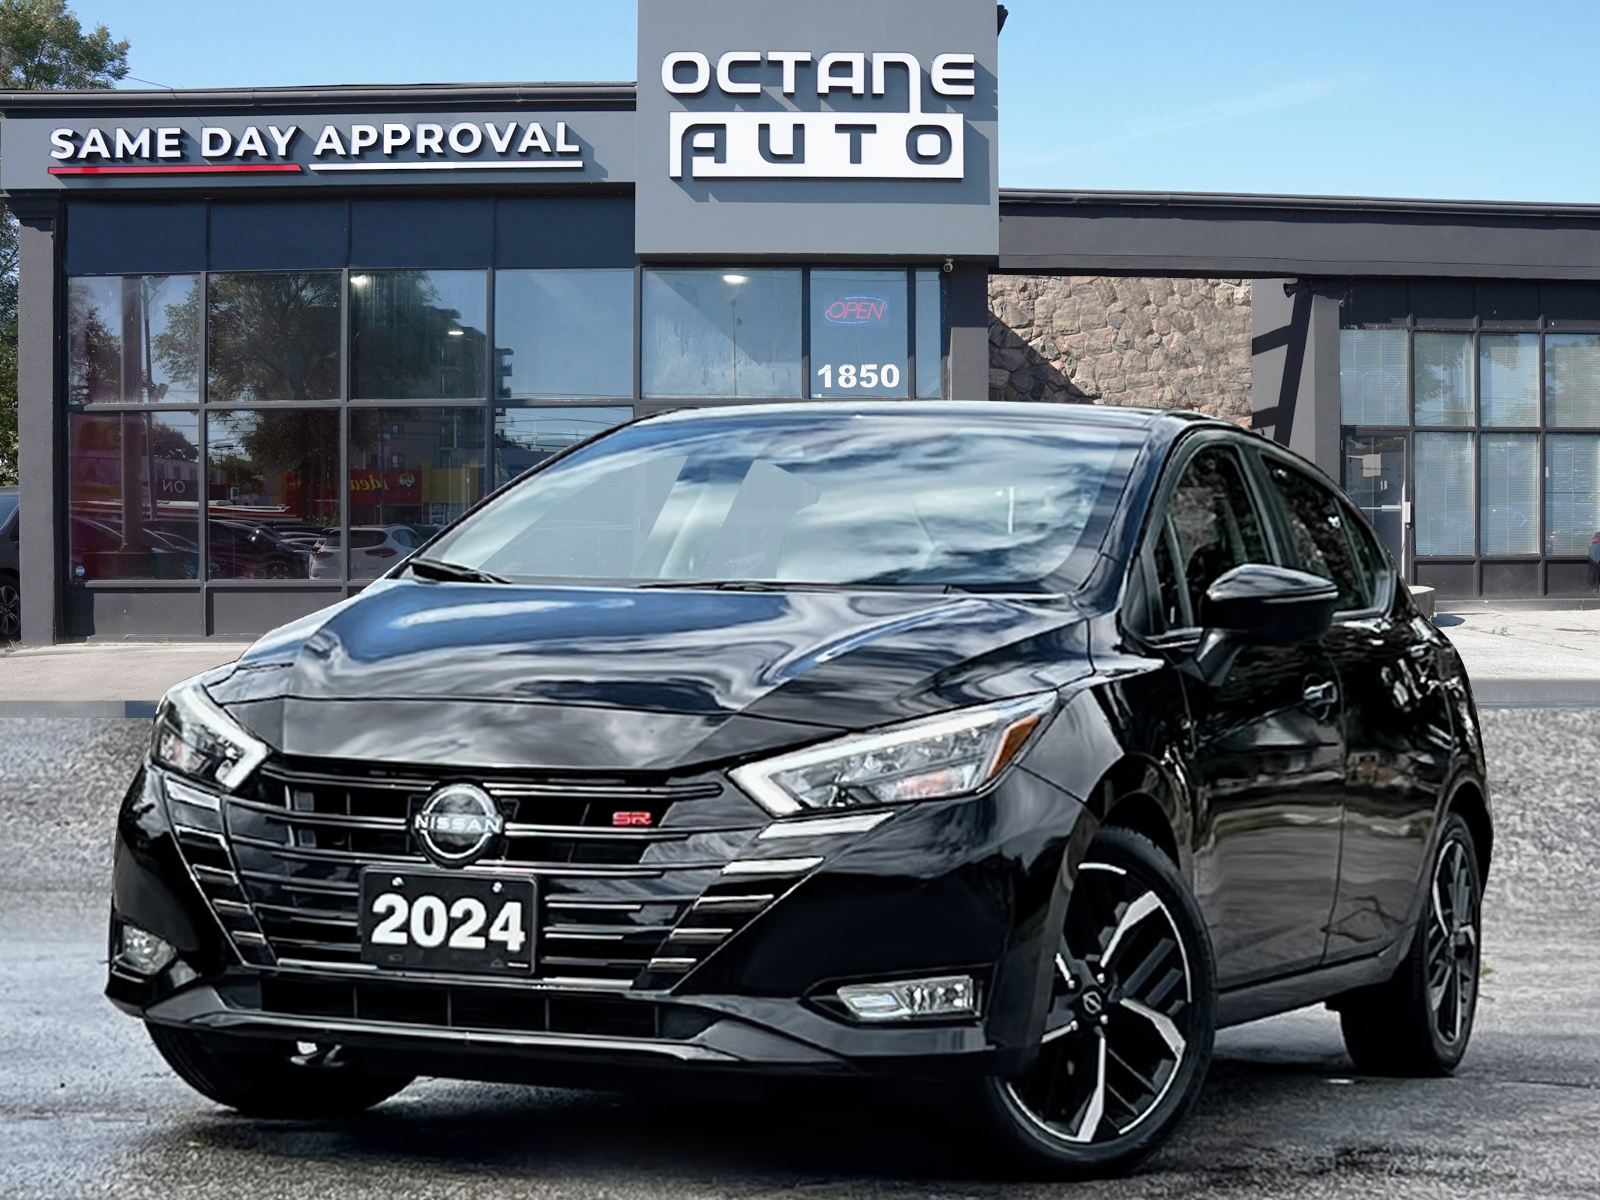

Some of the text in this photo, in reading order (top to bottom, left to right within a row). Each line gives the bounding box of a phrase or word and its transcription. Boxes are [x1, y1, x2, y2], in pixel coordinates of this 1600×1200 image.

[660, 50, 976, 112] OCTANE
[48, 121, 580, 160] SAME DAY APPROVAL
[680, 122, 954, 177] AUTO
[828, 301, 886, 320] OPEN
[817, 363, 900, 389] 1850
[414, 813, 504, 835] NISSAN
[612, 811, 652, 826] SR
[370, 892, 526, 954] 2024
